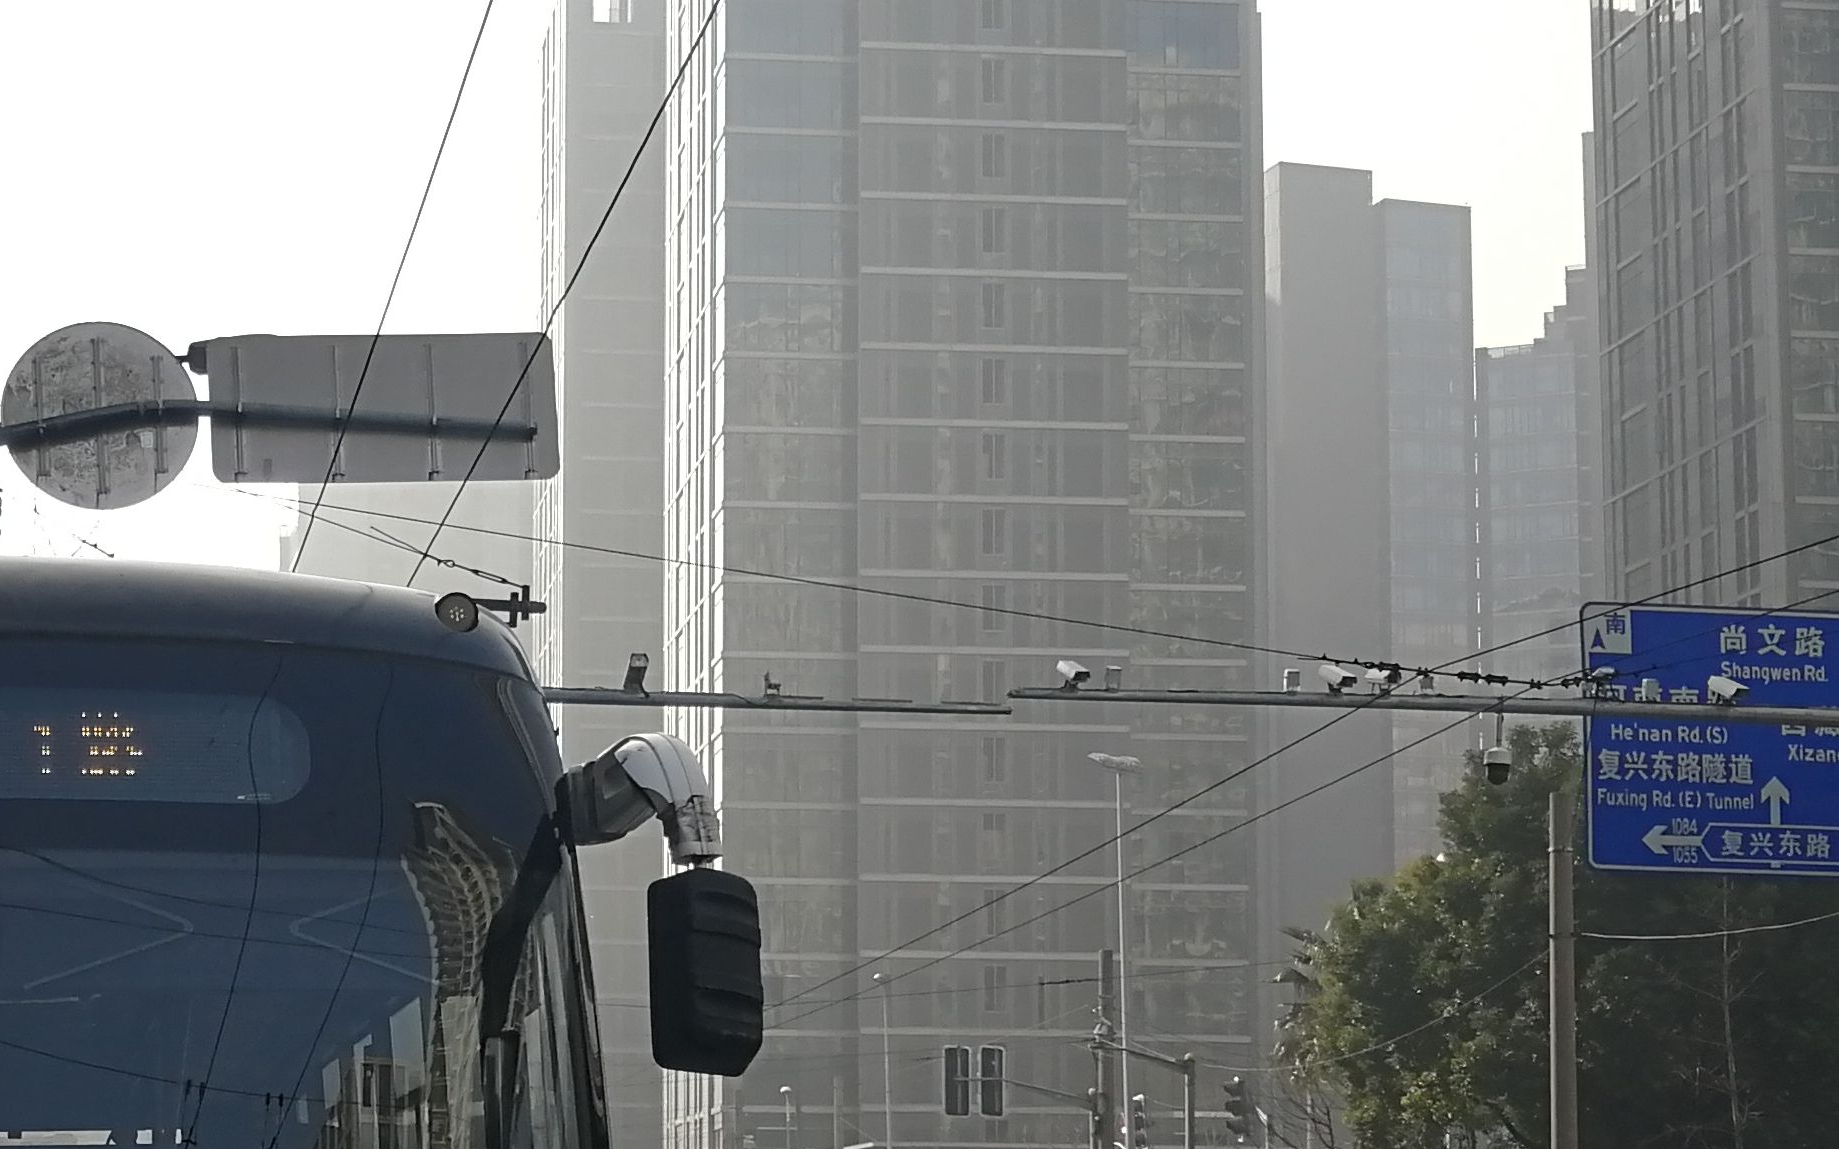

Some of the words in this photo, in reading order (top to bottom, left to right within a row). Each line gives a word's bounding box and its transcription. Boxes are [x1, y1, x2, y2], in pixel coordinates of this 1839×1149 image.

[1604, 612, 1626, 635] 南
[1719, 624, 1825, 658] 尚文路
[1720, 661, 1801, 685] Shangwen
[1804, 664, 1829, 682] Rd.
[1610, 722, 1672, 742] He'nan
[1677, 725, 1704, 744] Rd.
[1706, 726, 1728, 745] (S)
[1788, 743, 1839, 763] Xizan
[1597, 748, 1754, 785] 复兴东路隧道
[1596, 788, 1647, 811] Fuxing
[1652, 790, 1676, 808] Rd.
[1678, 790, 1702, 809] (E)
[1705, 792, 1755, 810] Tunnel
[1672, 818, 1698, 835] 1084
[1721, 830, 1831, 859] 复兴东路
